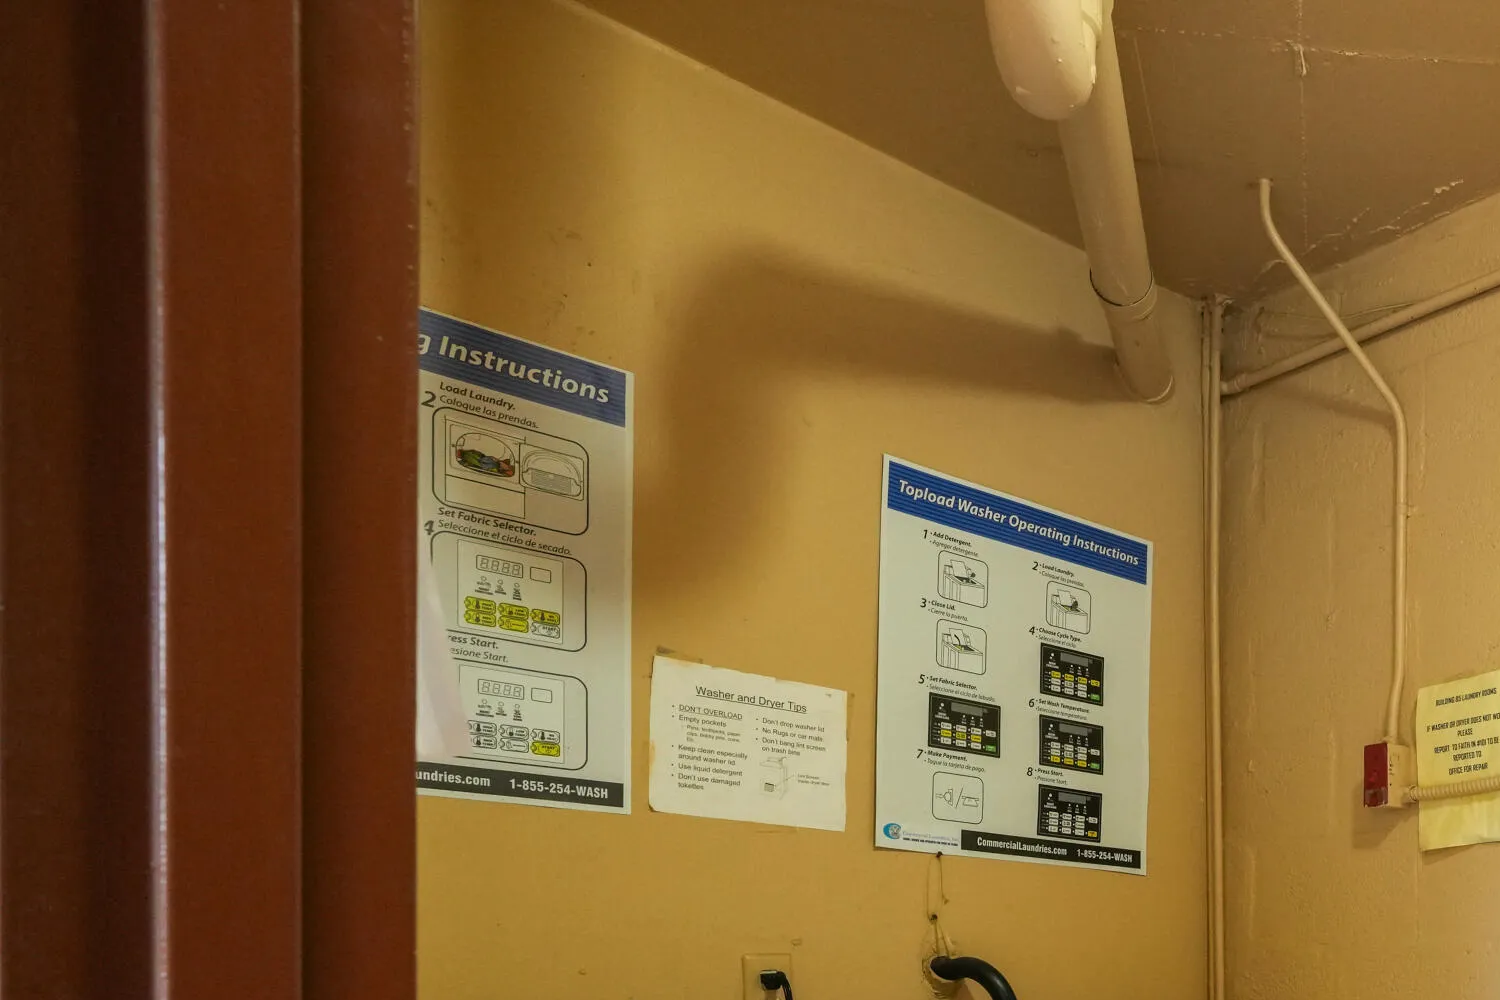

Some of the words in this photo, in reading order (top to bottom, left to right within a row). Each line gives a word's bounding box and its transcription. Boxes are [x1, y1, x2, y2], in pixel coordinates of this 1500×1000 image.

[438, 335, 610, 403] Instructions
[421, 391, 436, 408] 2
[439, 382, 467, 397] Load
[469, 389, 516, 412] Laundry.
[439, 395, 482, 414] Coloque
[483, 405, 497, 418] las
[498, 412, 541, 429] prendas.
[438, 507, 456, 518] Set
[458, 511, 492, 526] Fabric
[493, 518, 537, 537] Selector.
[899, 480, 956, 509] Topload
[959, 498, 1007, 524] Washer
[1009, 515, 1070, 546] Operating
[1073, 534, 1140, 567] Instructions
[438, 519, 490, 538] Seleccione
[491, 531, 499, 540] el
[501, 533, 524, 545] ciclo
[525, 537, 537, 549] de
[923, 529, 928, 539] 1
[932, 531, 944, 539] Add
[1031, 561, 1039, 571] 2
[919, 597, 927, 608] 3
[931, 599, 946, 608] Close
[1028, 626, 1035, 636] 4
[447, 633, 468, 645] ress
[469, 635, 499, 650] Start.
[483, 650, 509, 663] Start.
[918, 673, 925, 684] 5
[938, 677, 955, 686] Fabric
[695, 685, 735, 700] Washer
[737, 694, 756, 704] and
[758, 696, 785, 710] Dryer
[788, 700, 808, 714] Tips
[1028, 698, 1035, 708] 6
[703, 707, 743, 720] OVERLOAD
[678, 714, 700, 724] Empty
[701, 719, 727, 728] pockets
[762, 717, 779, 726] Don't
[780, 720, 794, 728] drop
[795, 723, 816, 731] washer
[817, 725, 825, 733] lid
[1431, 722, 1449, 732] WASHER
[1449, 721, 1455, 729] OR
[1470, 715, 1482, 724] DOES
[1482, 713, 1492, 722] NOT
[773, 728, 789, 738] Rugs
[1457, 728, 1473, 737] PLEASE
[761, 736, 778, 746] Don't
[806, 744, 826, 752] screen
[1452, 743, 1458, 751] TO
[1487, 737, 1493, 746] TO
[1493, 735, 1499, 744] BE
[678, 744, 696, 753] Keep
[697, 748, 715, 756] clean
[771, 746, 786, 754] trash
[916, 748, 924, 759] 7
[927, 750, 943, 758] Make
[1453, 751, 1476, 762] REPORTED
[1476, 750, 1482, 758] TO
[678, 753, 702, 762] around
[702, 756, 727, 765] washer
[678, 762, 692, 770] Use
[693, 765, 711, 773] liquid
[711, 767, 743, 777] detergent
[1026, 767, 1033, 777] 8
[1449, 766, 1463, 776] OFFICE
[1463, 765, 1472, 773] FOR
[1472, 762, 1488, 772] REPAIR
[416, 770, 491, 787] undries.com
[509, 778, 609, 799] 1-855-254-WASH
[678, 772, 695, 781] Don't
[711, 778, 741, 787] damaged
[976, 836, 1068, 857] CommercialLaundries.com
[1076, 848, 1133, 864] 1-855-254-WASH
